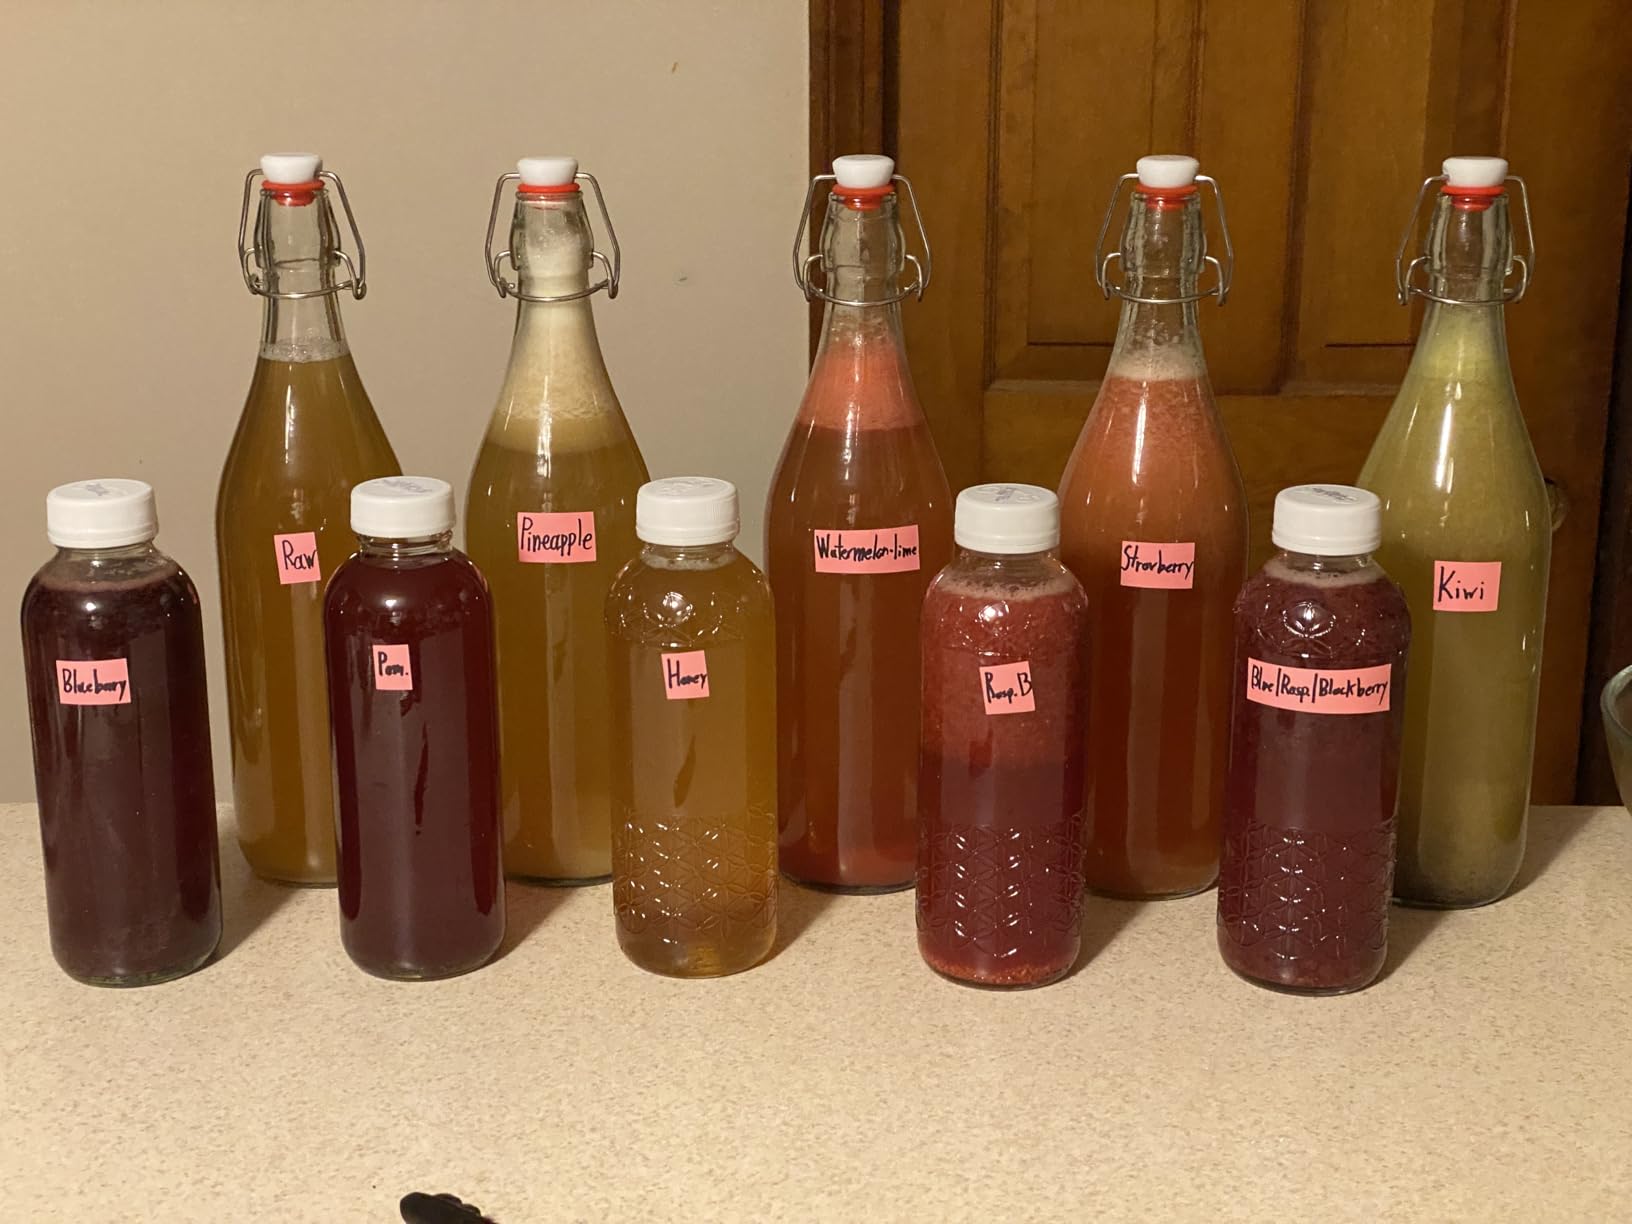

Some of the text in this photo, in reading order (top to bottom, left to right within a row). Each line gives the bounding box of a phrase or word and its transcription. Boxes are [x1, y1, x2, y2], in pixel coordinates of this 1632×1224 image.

[520, 516, 593, 556] Pineapple
[281, 539, 317, 570] Raw
[1437, 566, 1484, 603] Kiwi
[61, 668, 127, 701] Blueberry
[667, 658, 707, 688] Honey
